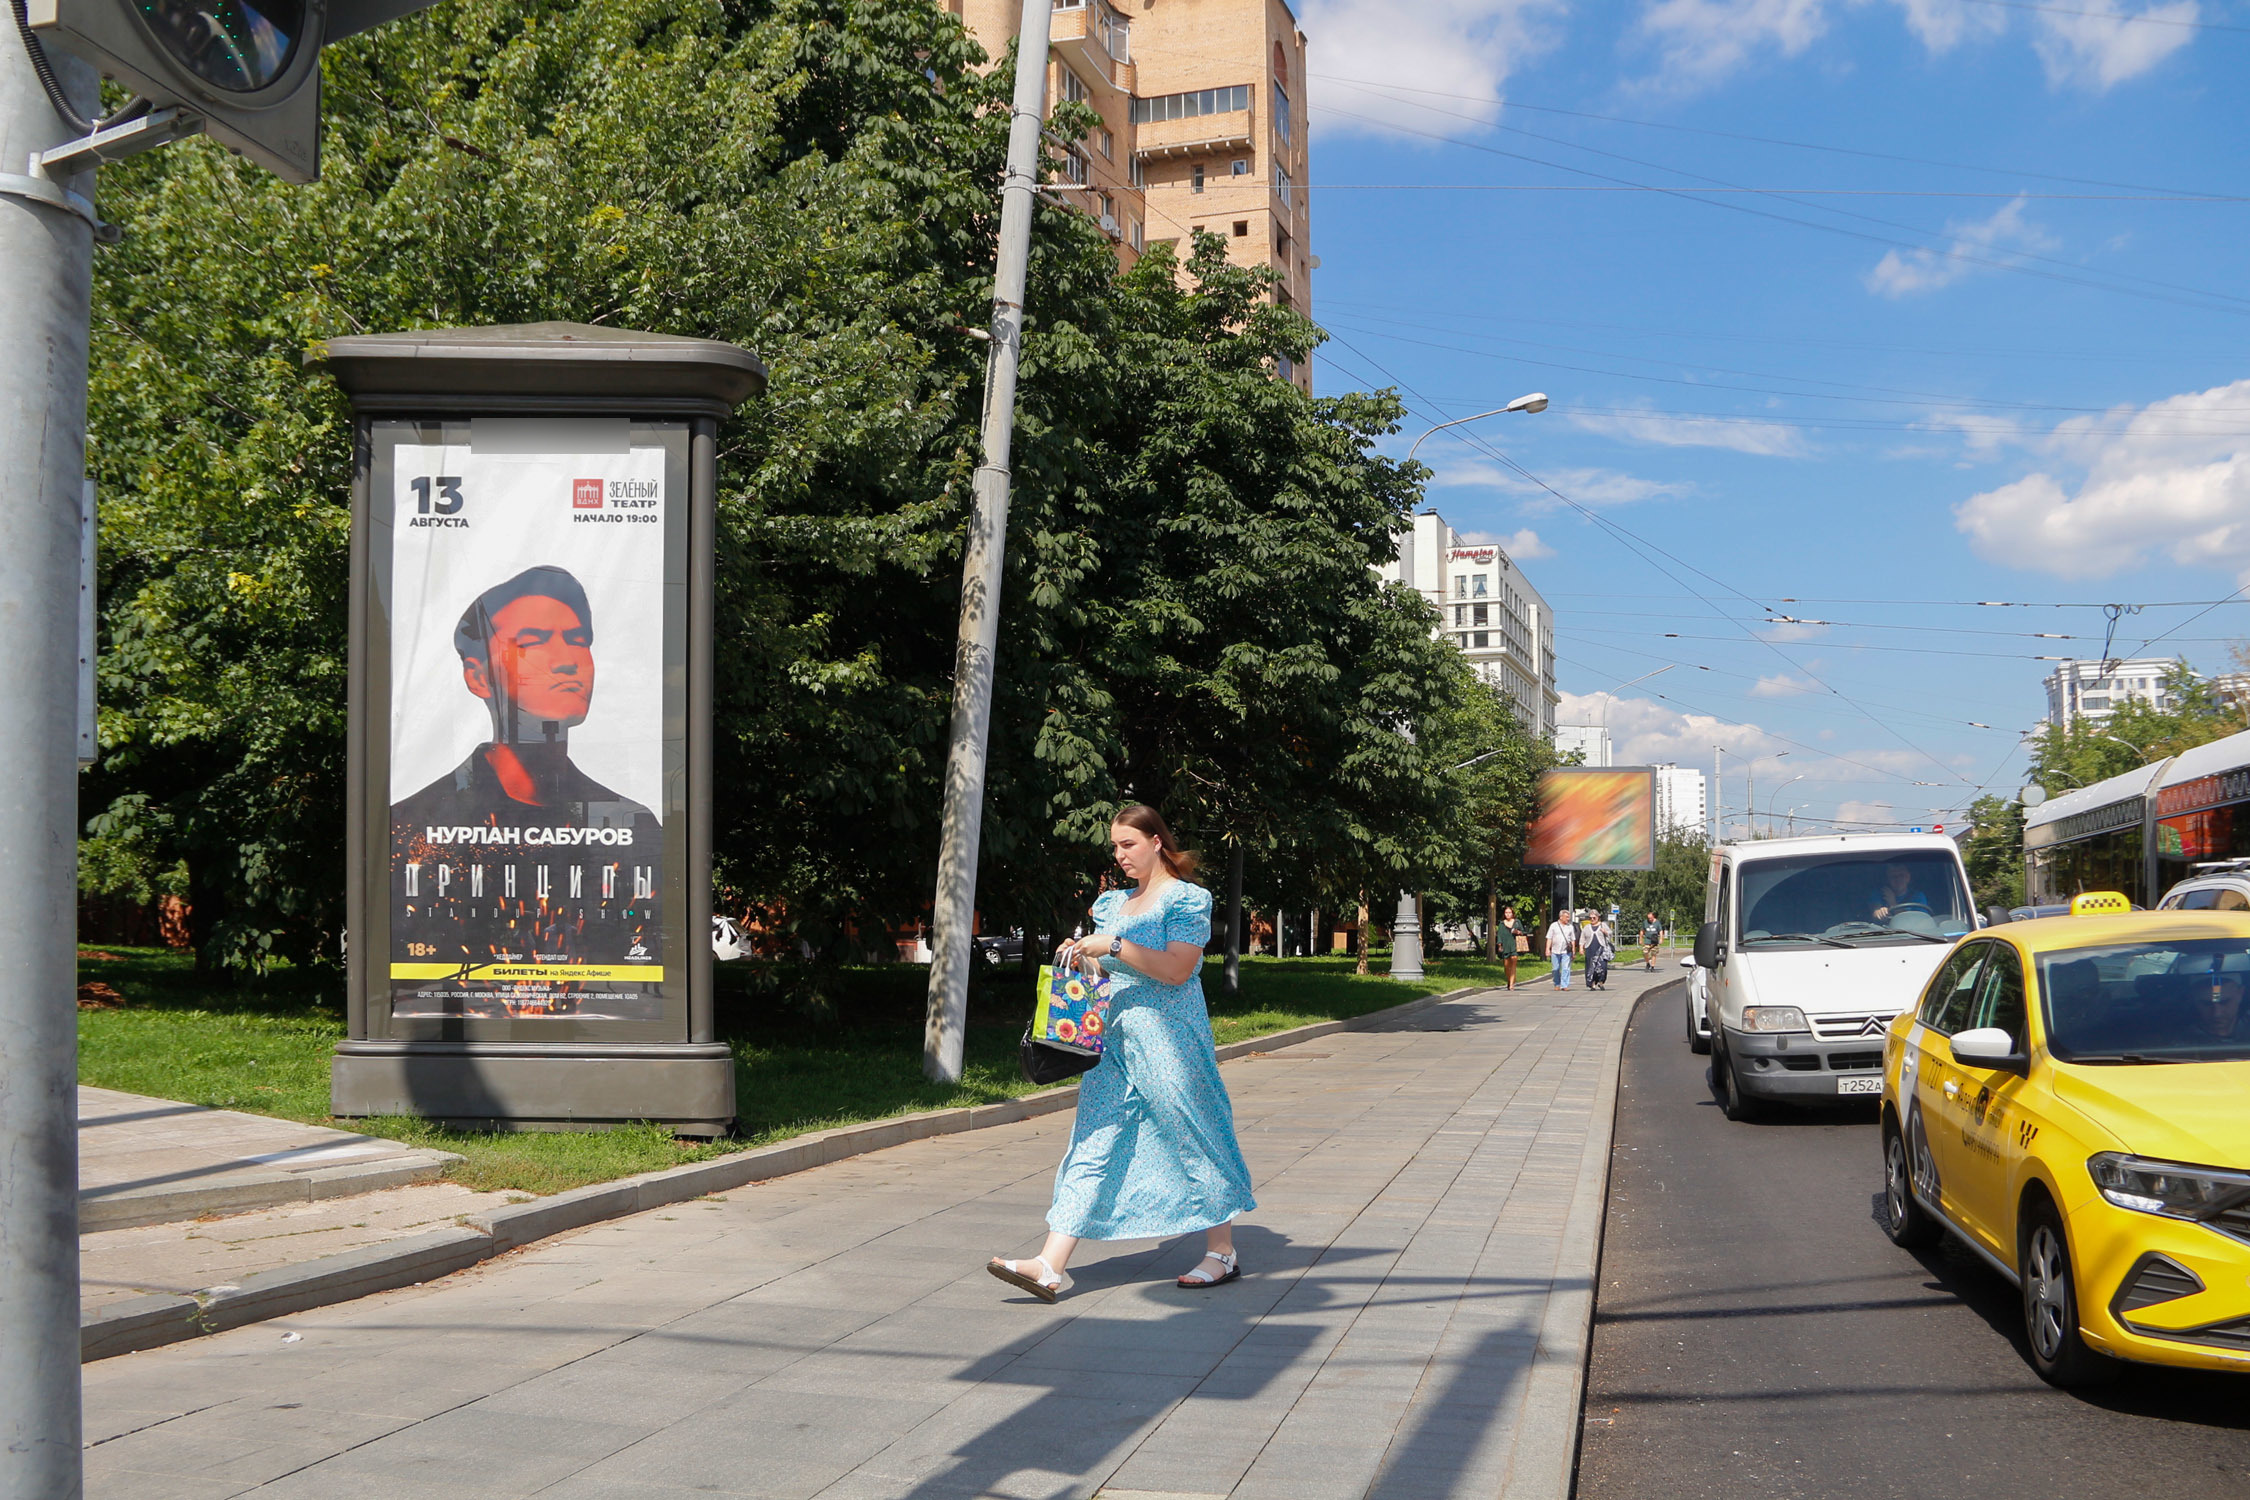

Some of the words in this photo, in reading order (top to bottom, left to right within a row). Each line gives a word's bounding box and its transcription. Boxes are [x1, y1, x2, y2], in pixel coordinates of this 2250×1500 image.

[411, 476, 464, 514] 13
[609, 478, 658, 498] ЗЕЛЁНЫЙ
[611, 500, 657, 509] ТЕАТР
[409, 517, 470, 529] АВГУСТА
[573, 514, 624, 523] НАЧАЛО
[626, 514, 658, 523] 19:00
[426, 826, 520, 846] НУРЛАН
[524, 827, 634, 846] САБУРОВ
[405, 863, 653, 900] ПРИНЦИПЫ
[407, 942, 437, 957] 18+
[493, 968, 548, 976] БИЛЕТЫ
[560, 969, 585, 977] Яндекс
[586, 969, 612, 977] Афише
